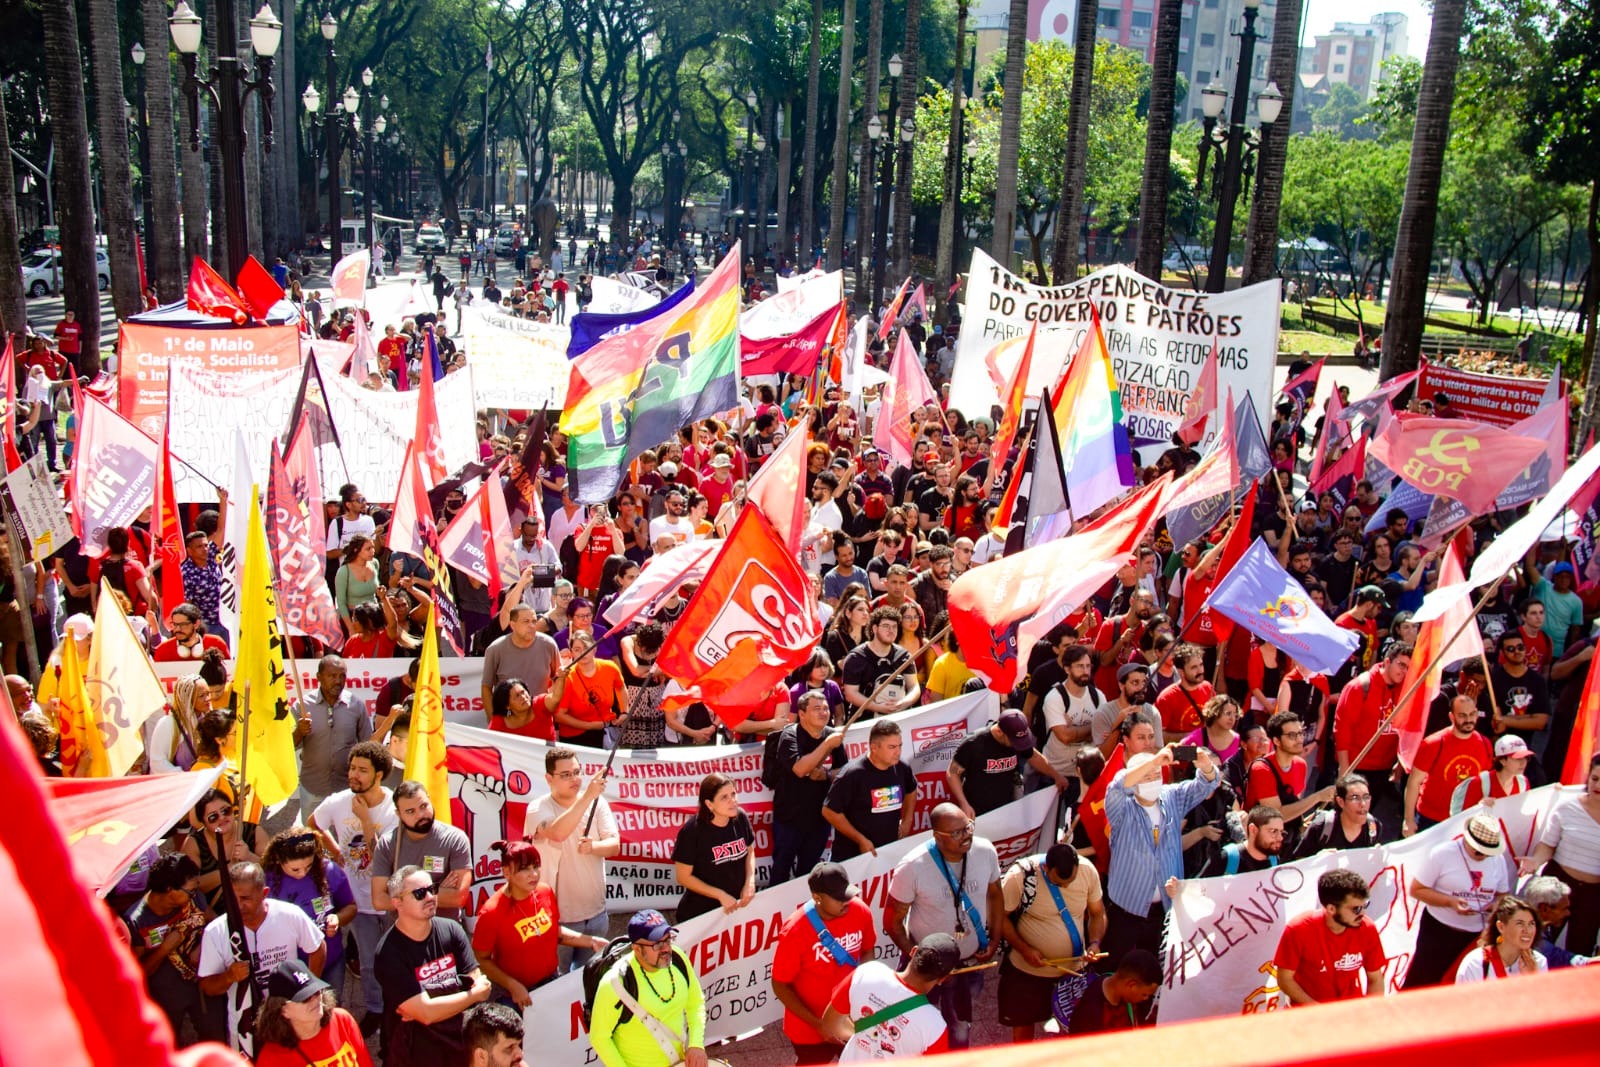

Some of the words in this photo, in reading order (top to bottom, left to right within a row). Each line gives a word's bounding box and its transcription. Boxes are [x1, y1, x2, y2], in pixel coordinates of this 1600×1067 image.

[1037, 274, 1208, 312] INDEPENDENTE
[990, 292, 1015, 316] DO
[1025, 300, 1117, 323] GOVERNO
[1126, 303, 1136, 323] E
[1147, 305, 1243, 336] PATRÕES
[184, 337, 205, 351] de
[211, 337, 254, 351] Maio
[1139, 336, 1158, 357] AS
[1166, 340, 1248, 370] REFORMAS
[210, 353, 279, 367] Socialista
[1113, 358, 1190, 392] RIZAÇÃO
[1426, 376, 1442, 387] Pela
[1444, 380, 1469, 392] vitória
[1471, 384, 1506, 398] operária
[1508, 391, 1520, 399] na
[1521, 391, 1542, 402] Fran
[1471, 396, 1500, 409] militar
[1501, 401, 1512, 411] da
[624, 755, 762, 779] INTERNACIONALIST
[987, 755, 1018, 771] PSTU
[619, 782, 641, 799] DO
[645, 783, 700, 798] GOVERN
[874, 786, 899, 798] CSP
[916, 780, 951, 800] STA,
[615, 809, 693, 832] REVOGU
[912, 805, 932, 831] JÁ
[712, 838, 747, 859] PSTU
[475, 855, 501, 878] de
[654, 869, 672, 880] DE
[605, 885, 629, 900] RA,
[633, 884, 684, 899] MORAD
[521, 916, 548, 937] PSTU
[419, 957, 452, 978] CSP
[730, 991, 767, 1017] DOS
